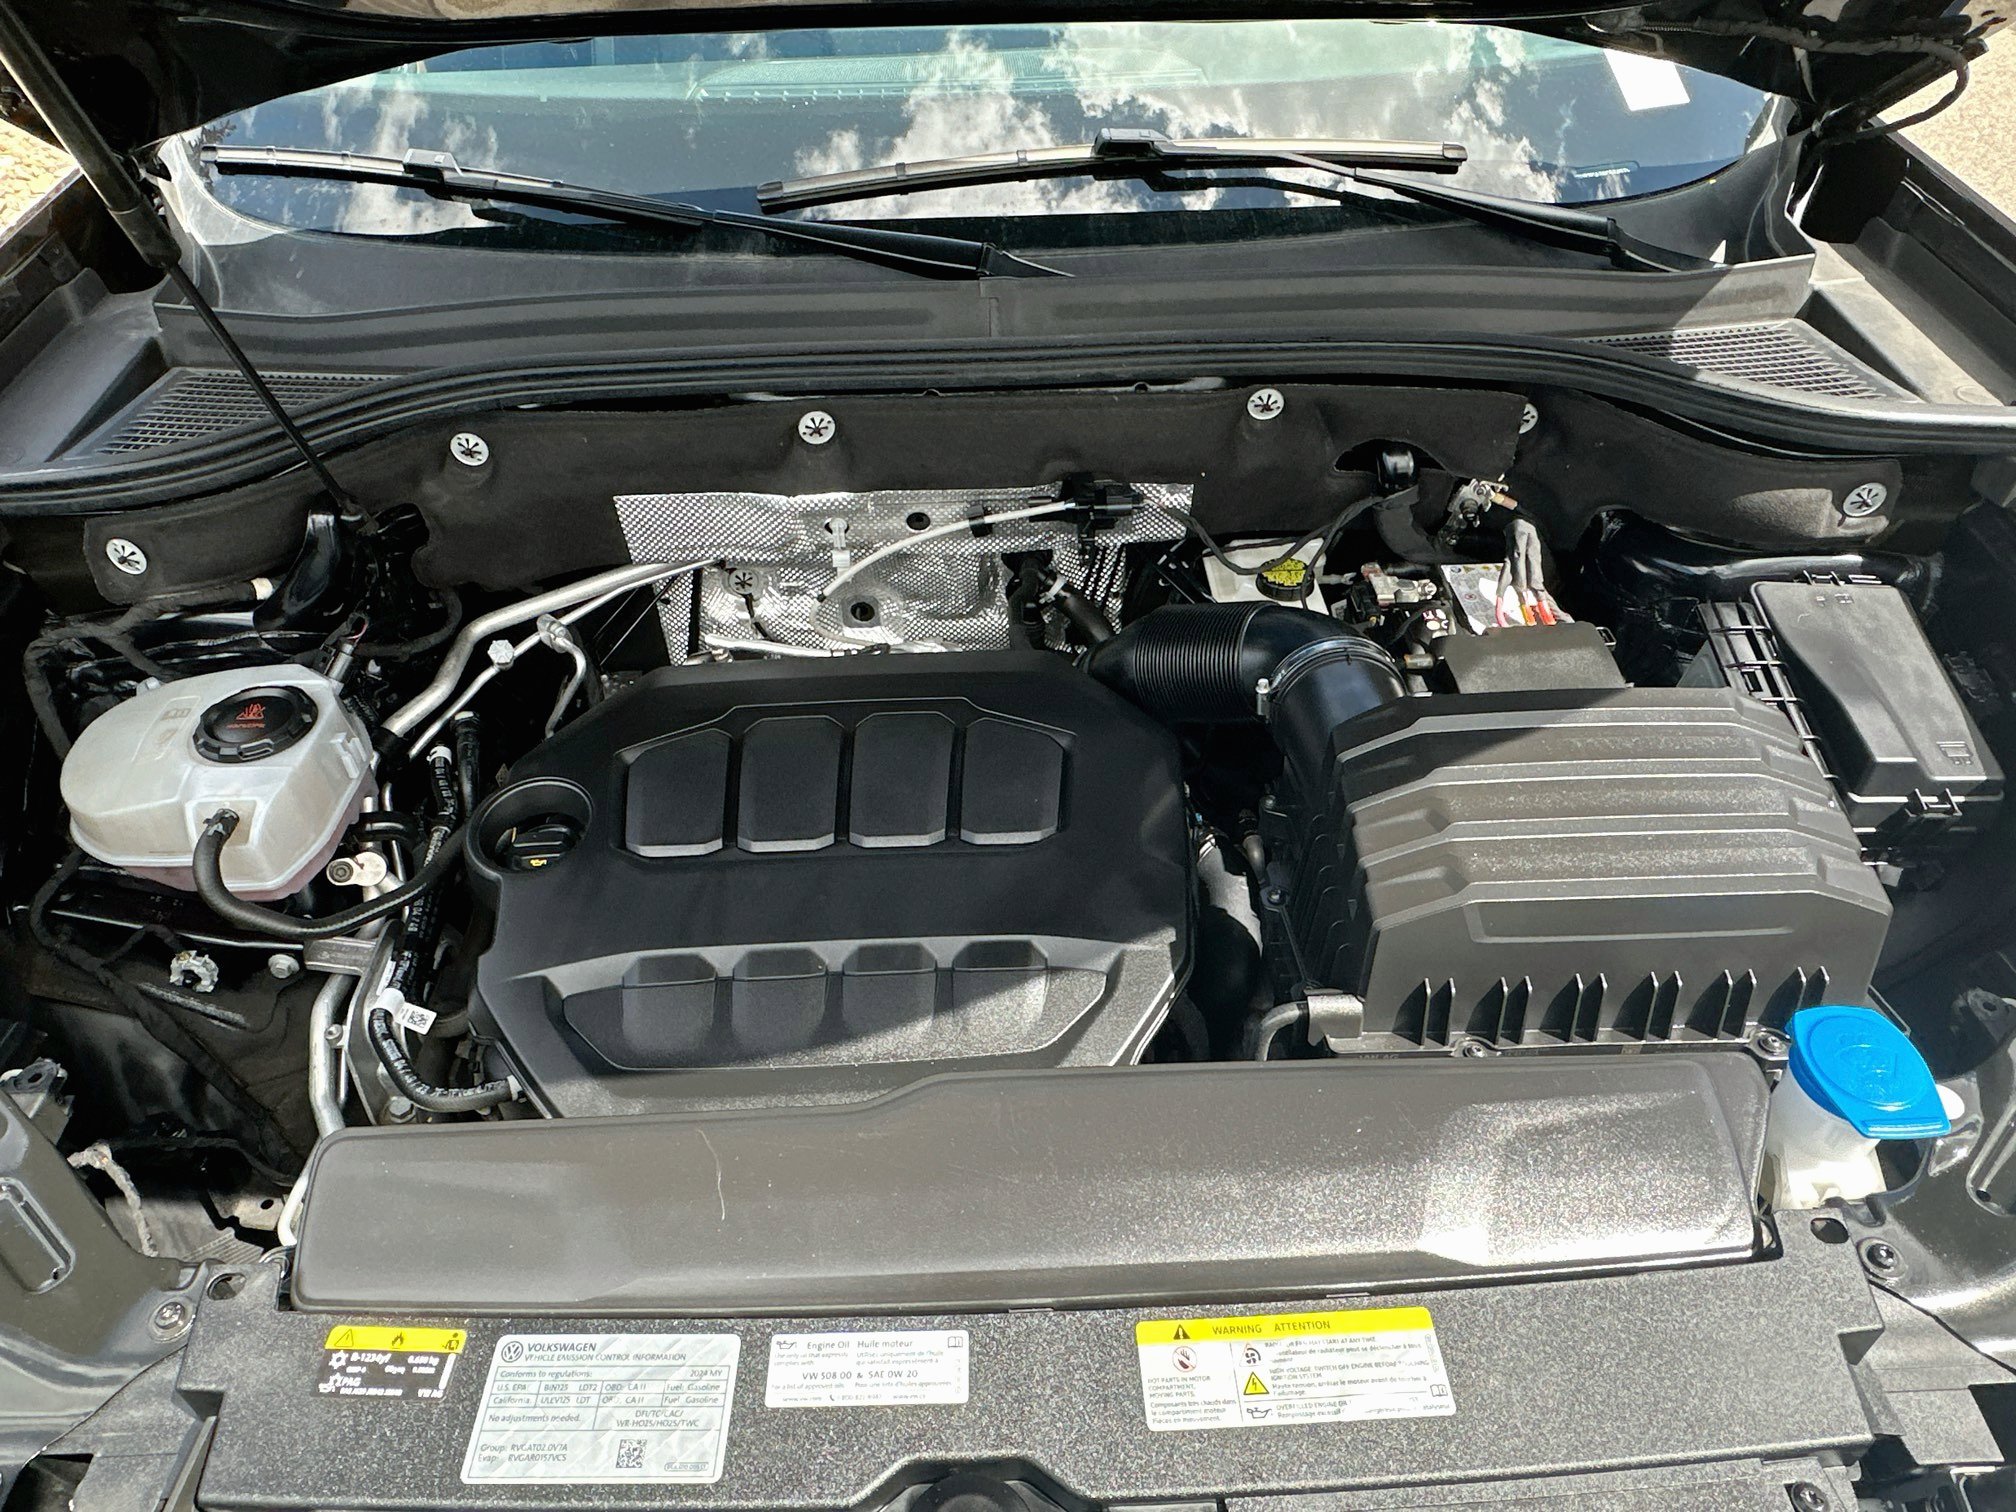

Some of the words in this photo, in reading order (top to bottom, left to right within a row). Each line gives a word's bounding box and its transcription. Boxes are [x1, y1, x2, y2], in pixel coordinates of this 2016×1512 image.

[1212, 1324, 1262, 1335] WARNING
[1274, 1320, 1331, 1332] ATTENTION
[527, 1343, 597, 1352] VOLKSWAGEN
[807, 1341, 835, 1351] Engine
[838, 1341, 850, 1349] Oil
[857, 1340, 879, 1348] Huile
[882, 1340, 913, 1348] moteur
[633, 1353, 686, 1361] INFORMATION
[500, 1370, 537, 1378] Conforms
[802, 1372, 818, 1380] VW
[821, 1371, 837, 1380] 508
[840, 1371, 852, 1379] 00
[906, 1370, 918, 1378] 20
[687, 1383, 720, 1391] Gasoline
[493, 1396, 530, 1404] California
[685, 1396, 719, 1404] Gasoline
[501, 1414, 549, 1424] adjustments
